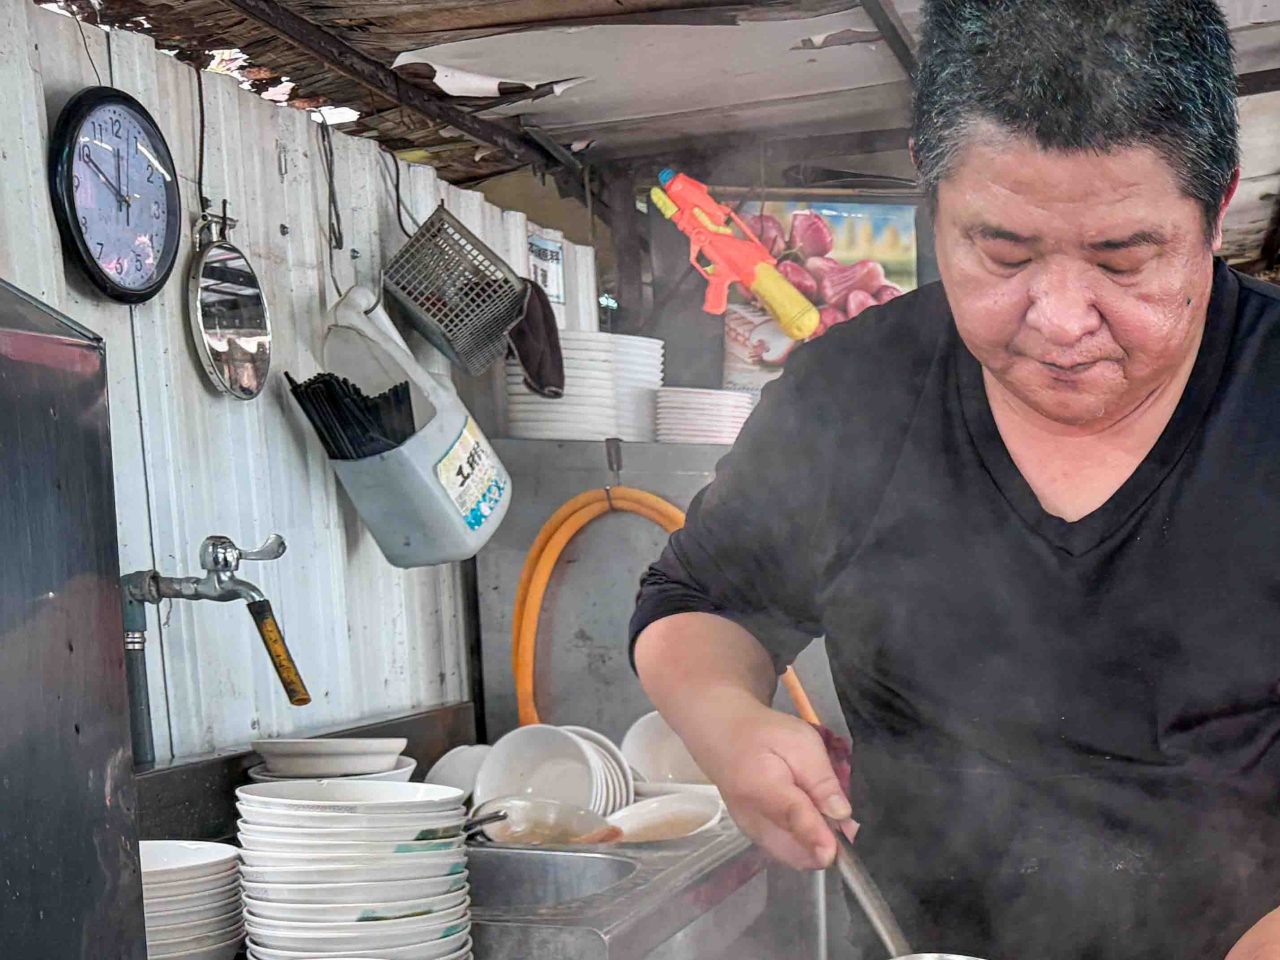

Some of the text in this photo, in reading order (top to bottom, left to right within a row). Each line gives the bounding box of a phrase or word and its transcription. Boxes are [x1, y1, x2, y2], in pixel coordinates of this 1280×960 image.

[110, 117, 122, 139] 12
[147, 165, 154, 184] 2
[96, 242, 104, 260] 7
